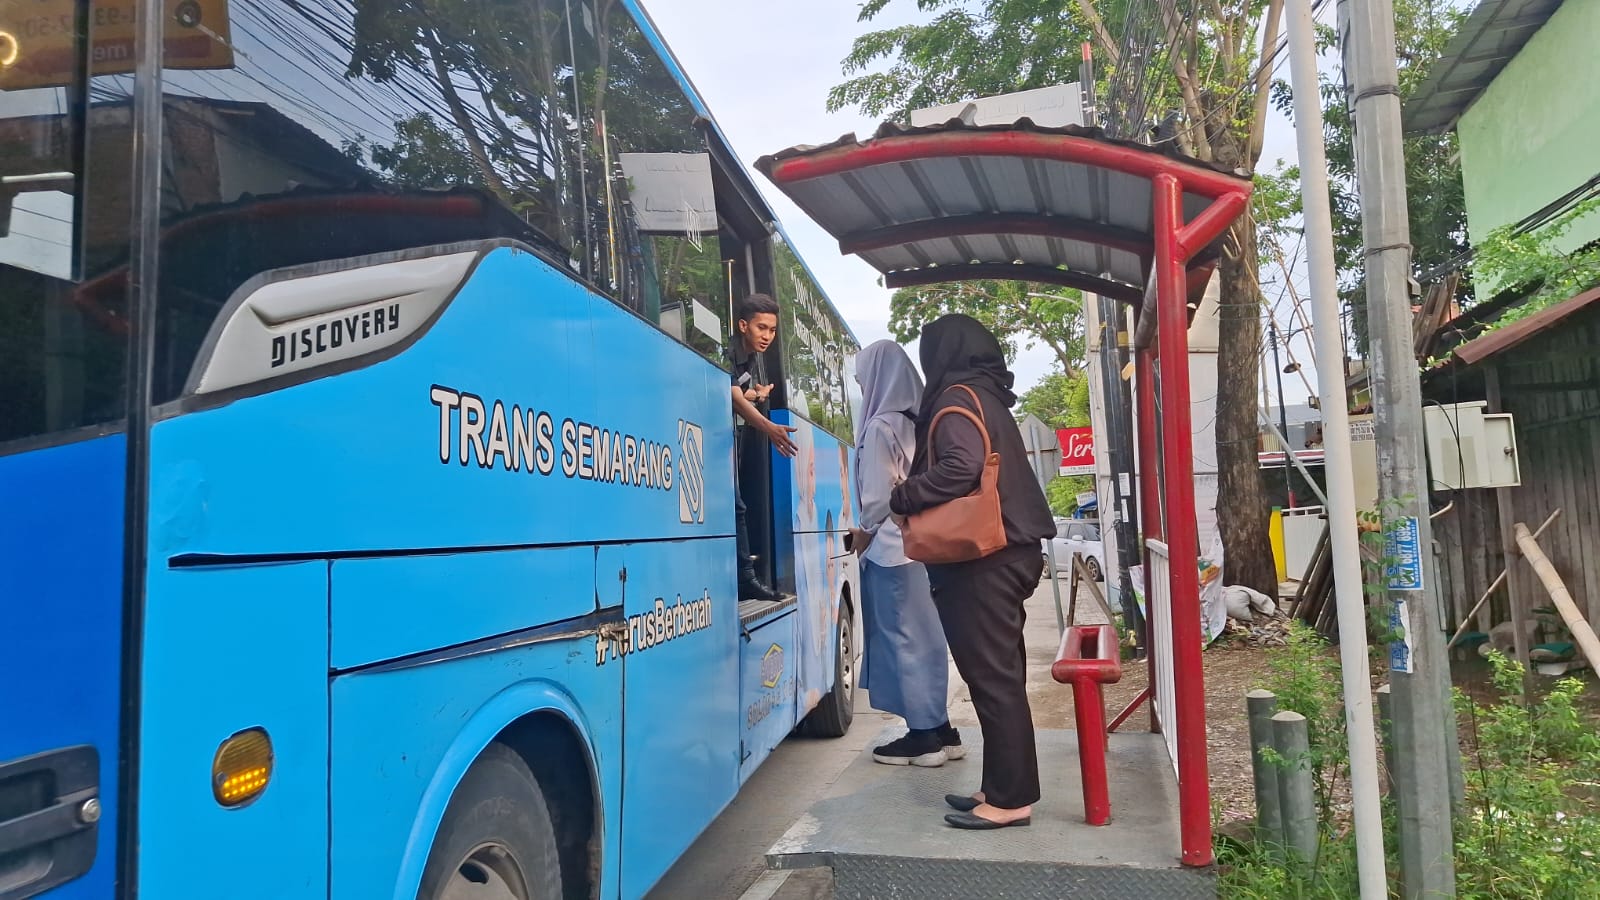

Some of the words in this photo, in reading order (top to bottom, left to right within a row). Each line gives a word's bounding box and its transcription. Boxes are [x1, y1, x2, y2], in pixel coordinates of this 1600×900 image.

[271, 303, 400, 368] DISCOVERY
[430, 384, 554, 477] TRANS
[561, 416, 673, 491] SEMARANG
